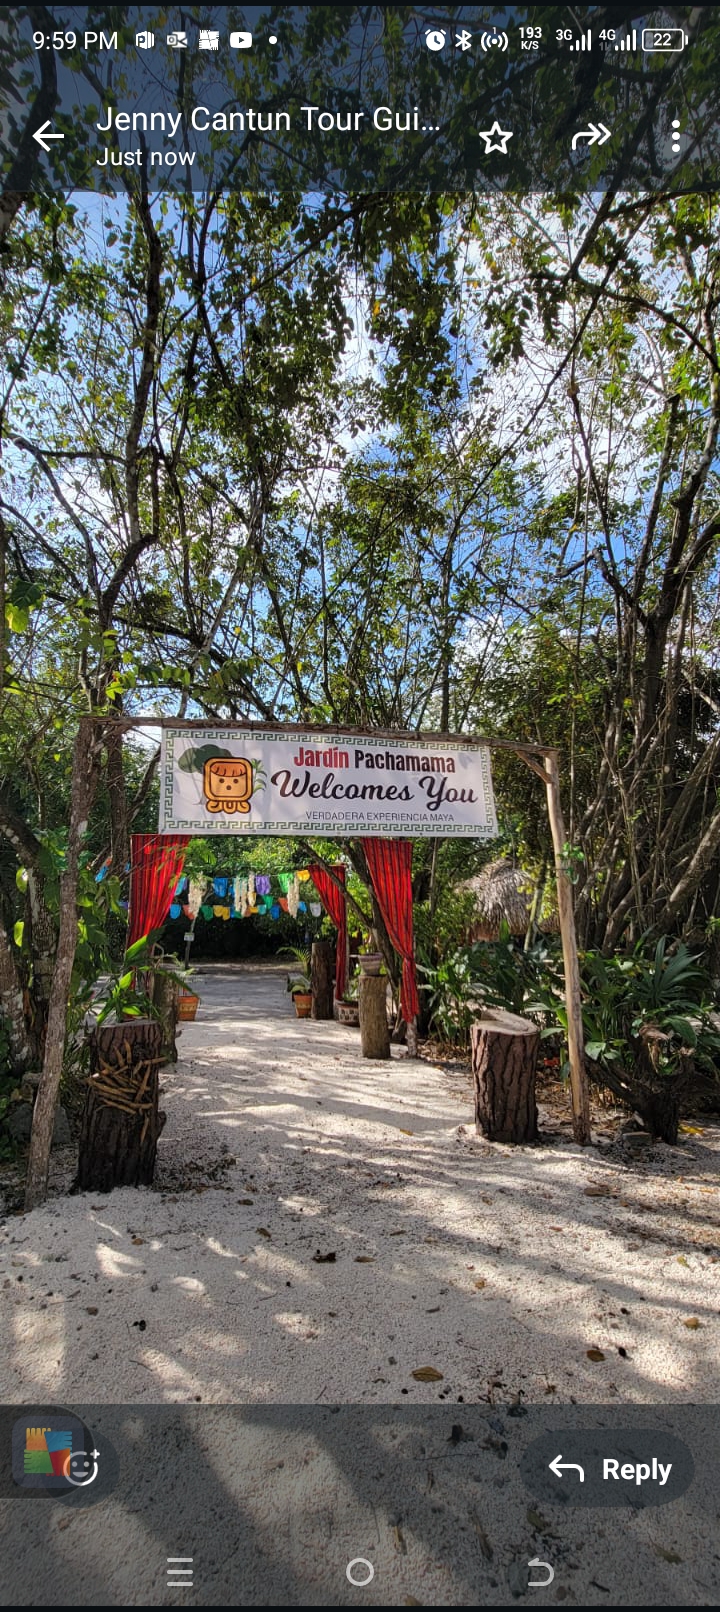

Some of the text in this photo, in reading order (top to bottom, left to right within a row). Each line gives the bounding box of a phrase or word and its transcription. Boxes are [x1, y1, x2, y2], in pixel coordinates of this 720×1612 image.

[293, 746, 455, 773] Jardín Pachamama
[270, 769, 478, 811] Welcomes You
[306, 811, 454, 822] VERDADERA EXPERIENCIA MAYA
